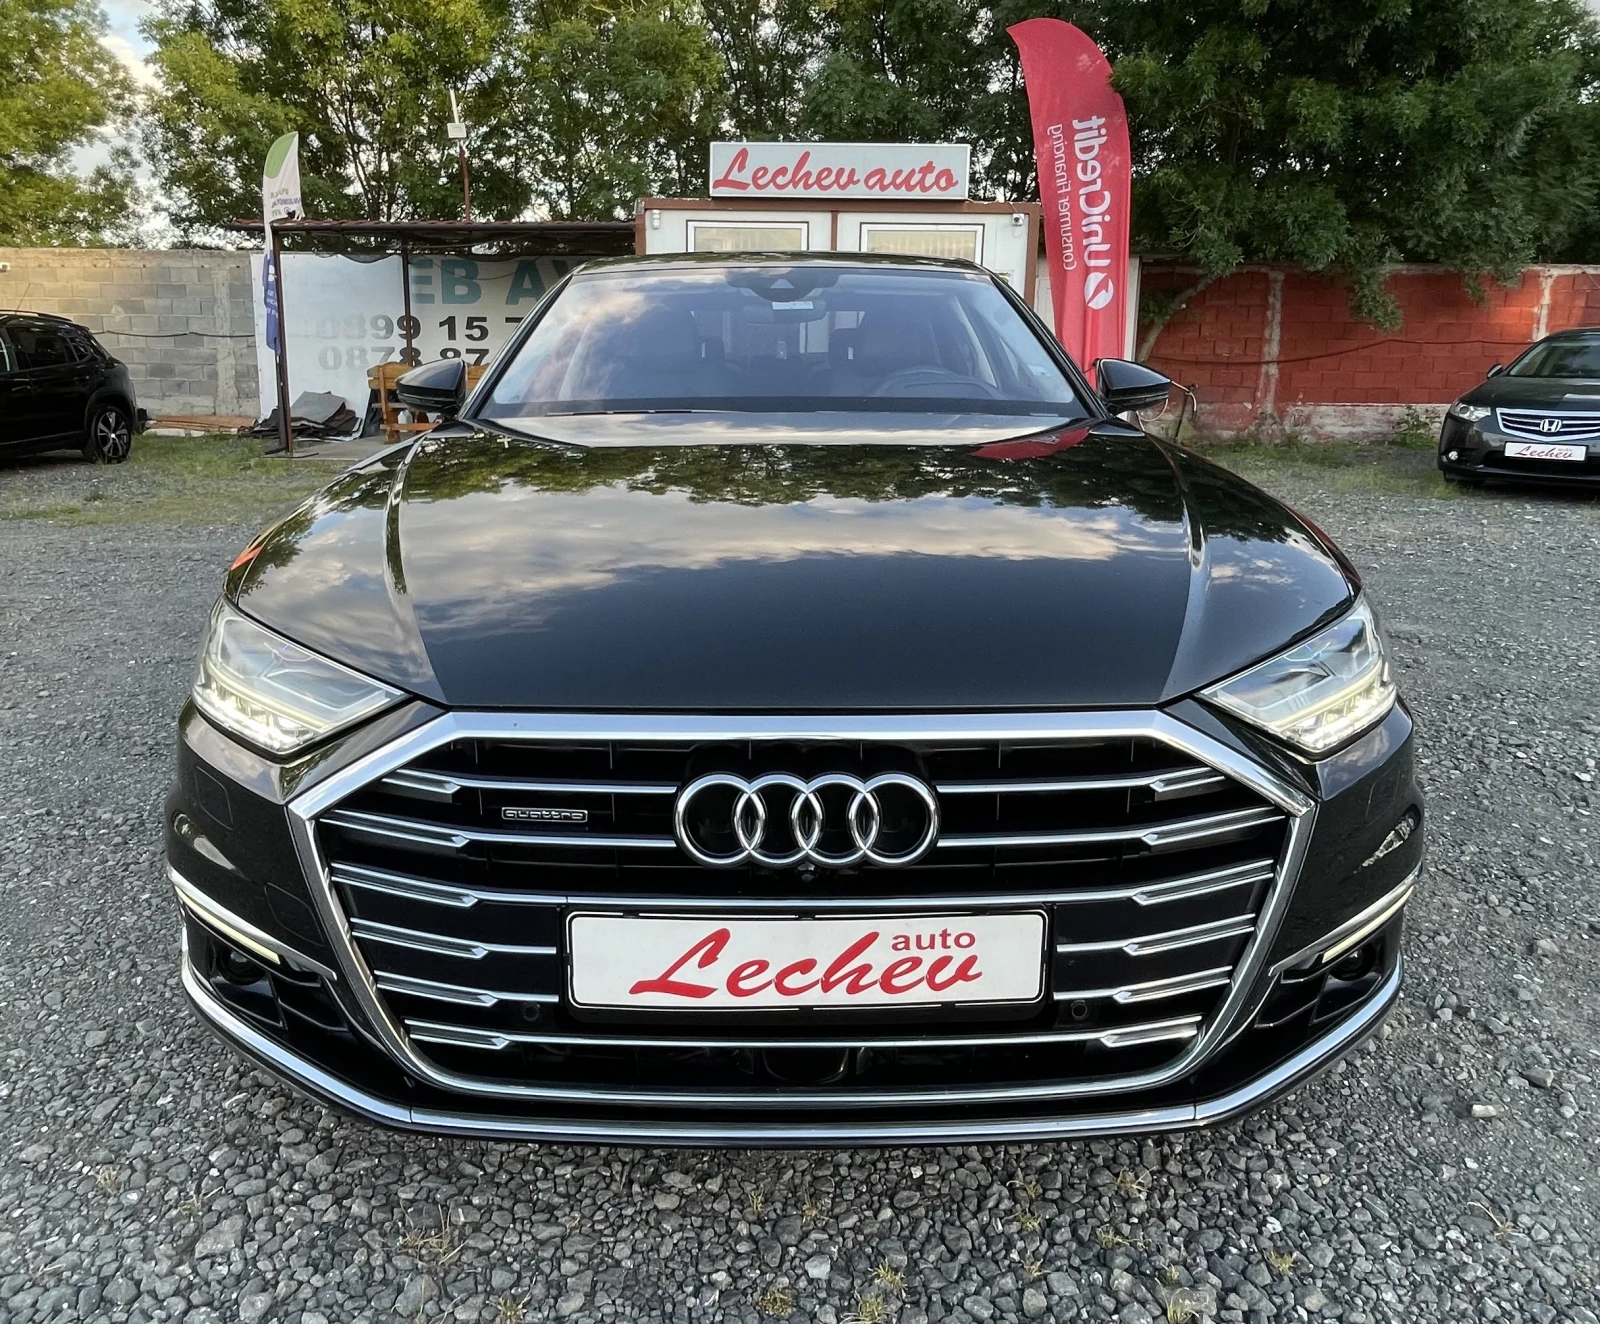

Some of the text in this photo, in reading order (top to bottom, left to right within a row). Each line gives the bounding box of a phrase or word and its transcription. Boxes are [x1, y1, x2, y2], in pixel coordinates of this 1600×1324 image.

[712, 147, 959, 193] Lechev auto
[438, 316, 489, 341] 15
[1514, 445, 1574, 458] Lechev
[505, 810, 584, 820] quattro
[891, 928, 976, 952] auto
[629, 928, 983, 999] Lechev
